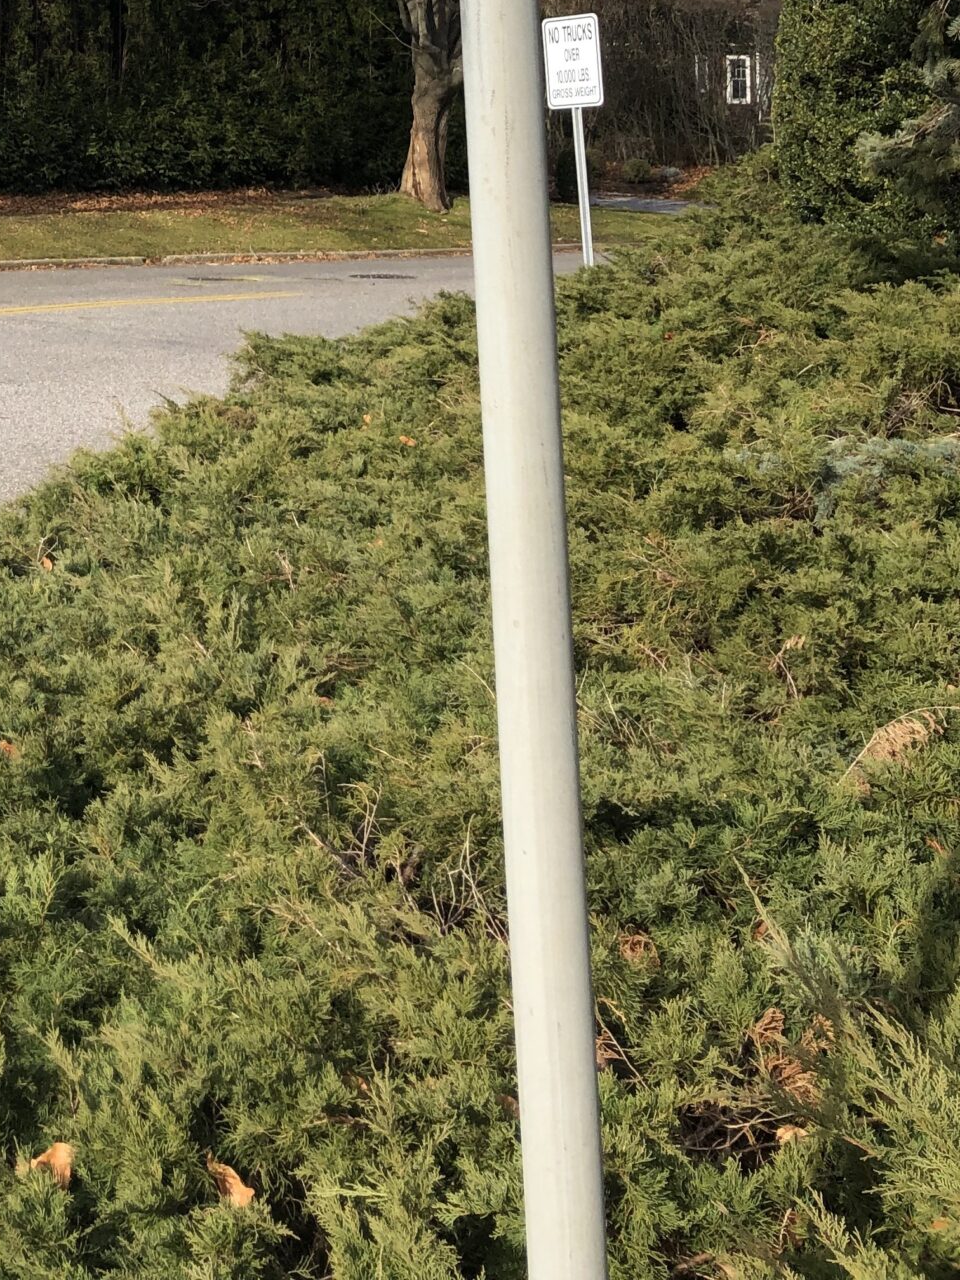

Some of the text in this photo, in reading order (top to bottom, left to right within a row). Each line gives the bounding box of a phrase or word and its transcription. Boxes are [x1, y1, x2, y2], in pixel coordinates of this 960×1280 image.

[548, 23, 593, 44] NO TRUCKS
[564, 47, 580, 62] OVER
[552, 85, 597, 99] GROSS WEIGHT
